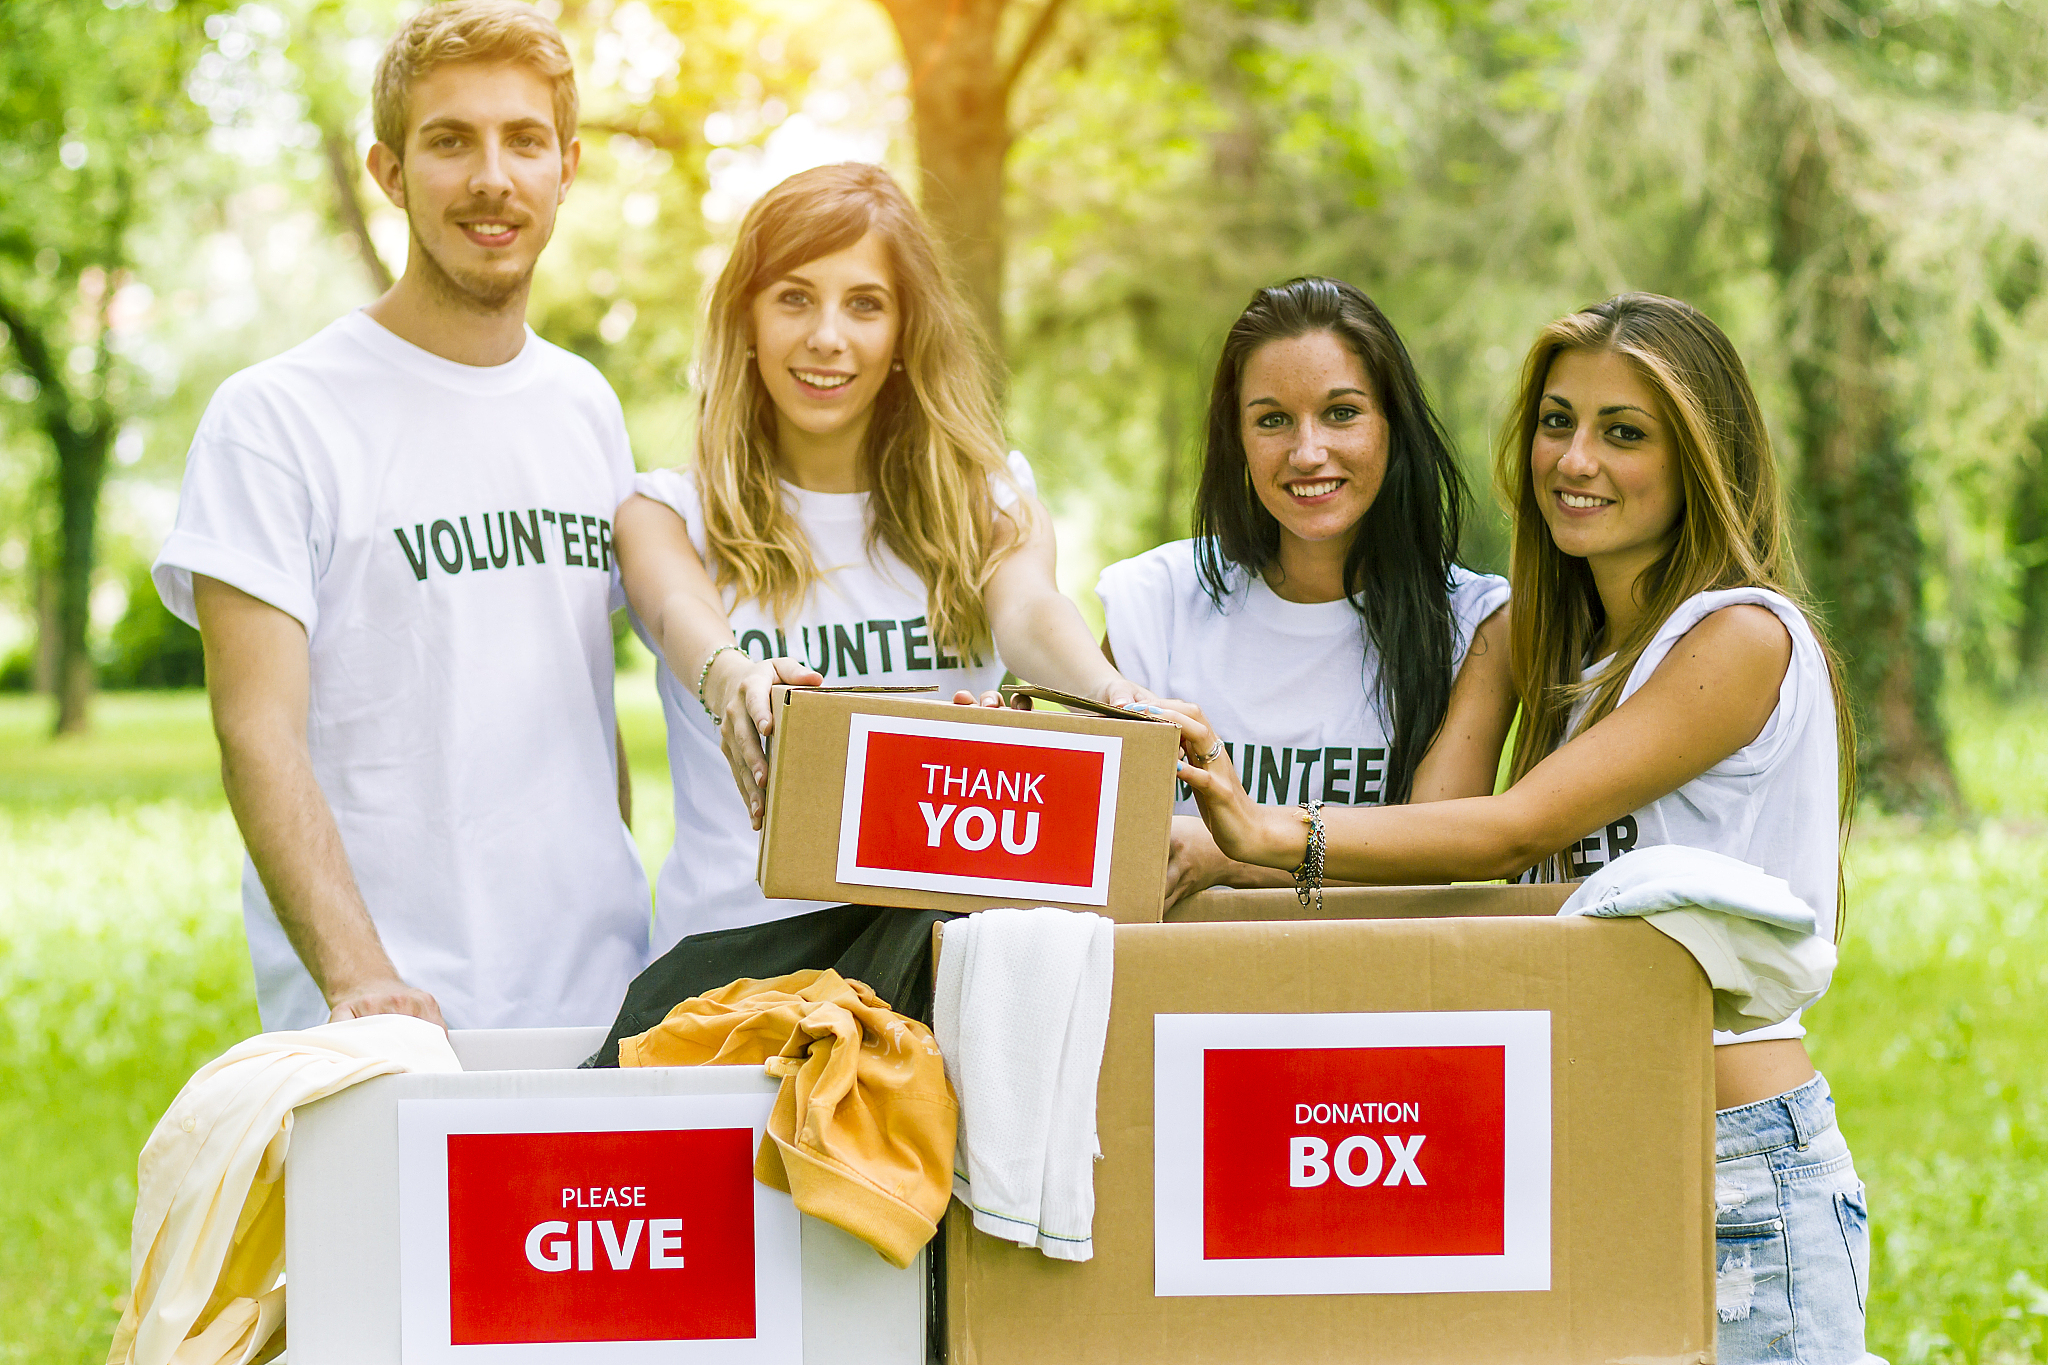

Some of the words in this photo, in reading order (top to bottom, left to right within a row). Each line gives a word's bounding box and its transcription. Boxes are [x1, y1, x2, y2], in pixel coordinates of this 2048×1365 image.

[921, 763, 1046, 804] THANK
[917, 801, 1041, 856] YOU
[1295, 1102, 1420, 1125] DONATION
[1289, 1134, 1428, 1188] BOX
[562, 1186, 647, 1209] PLEASE
[524, 1218, 685, 1273] GIVE
